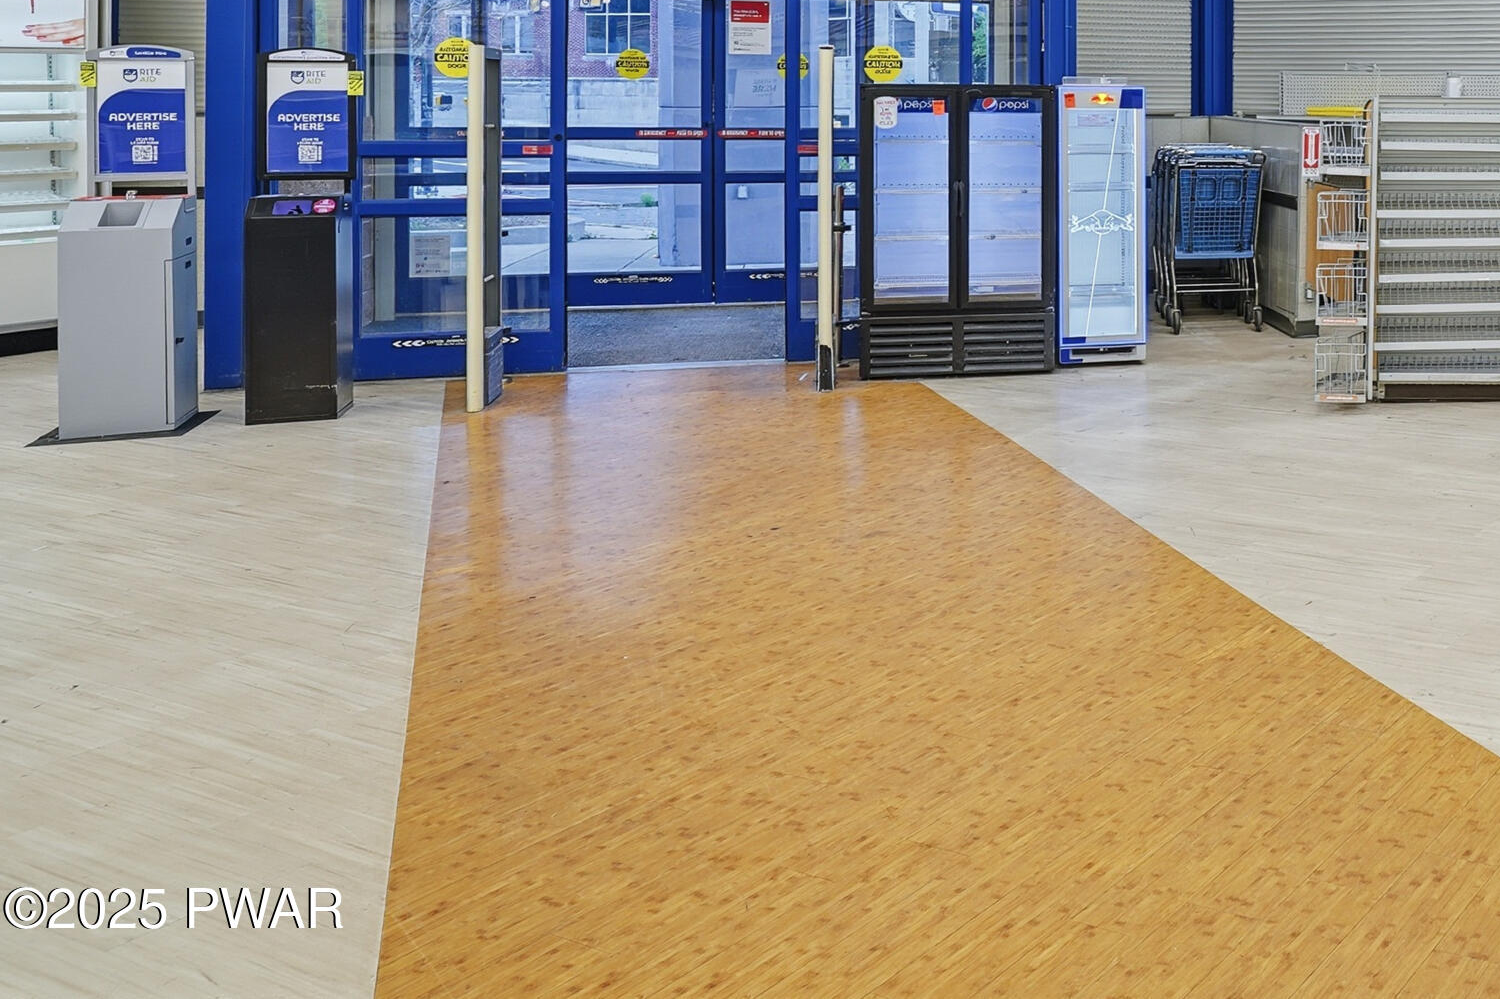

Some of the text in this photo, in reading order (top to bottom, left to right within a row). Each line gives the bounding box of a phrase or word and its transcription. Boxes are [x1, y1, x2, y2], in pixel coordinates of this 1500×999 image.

[139, 68, 162, 76] RITE
[903, 100, 933, 111] peps
[998, 99, 1029, 111] pepsi
[108, 112, 178, 122] ADVERTISE
[277, 113, 341, 122] ADVERTISE
[126, 122, 160, 130] HERE
[293, 122, 325, 131] HERE
